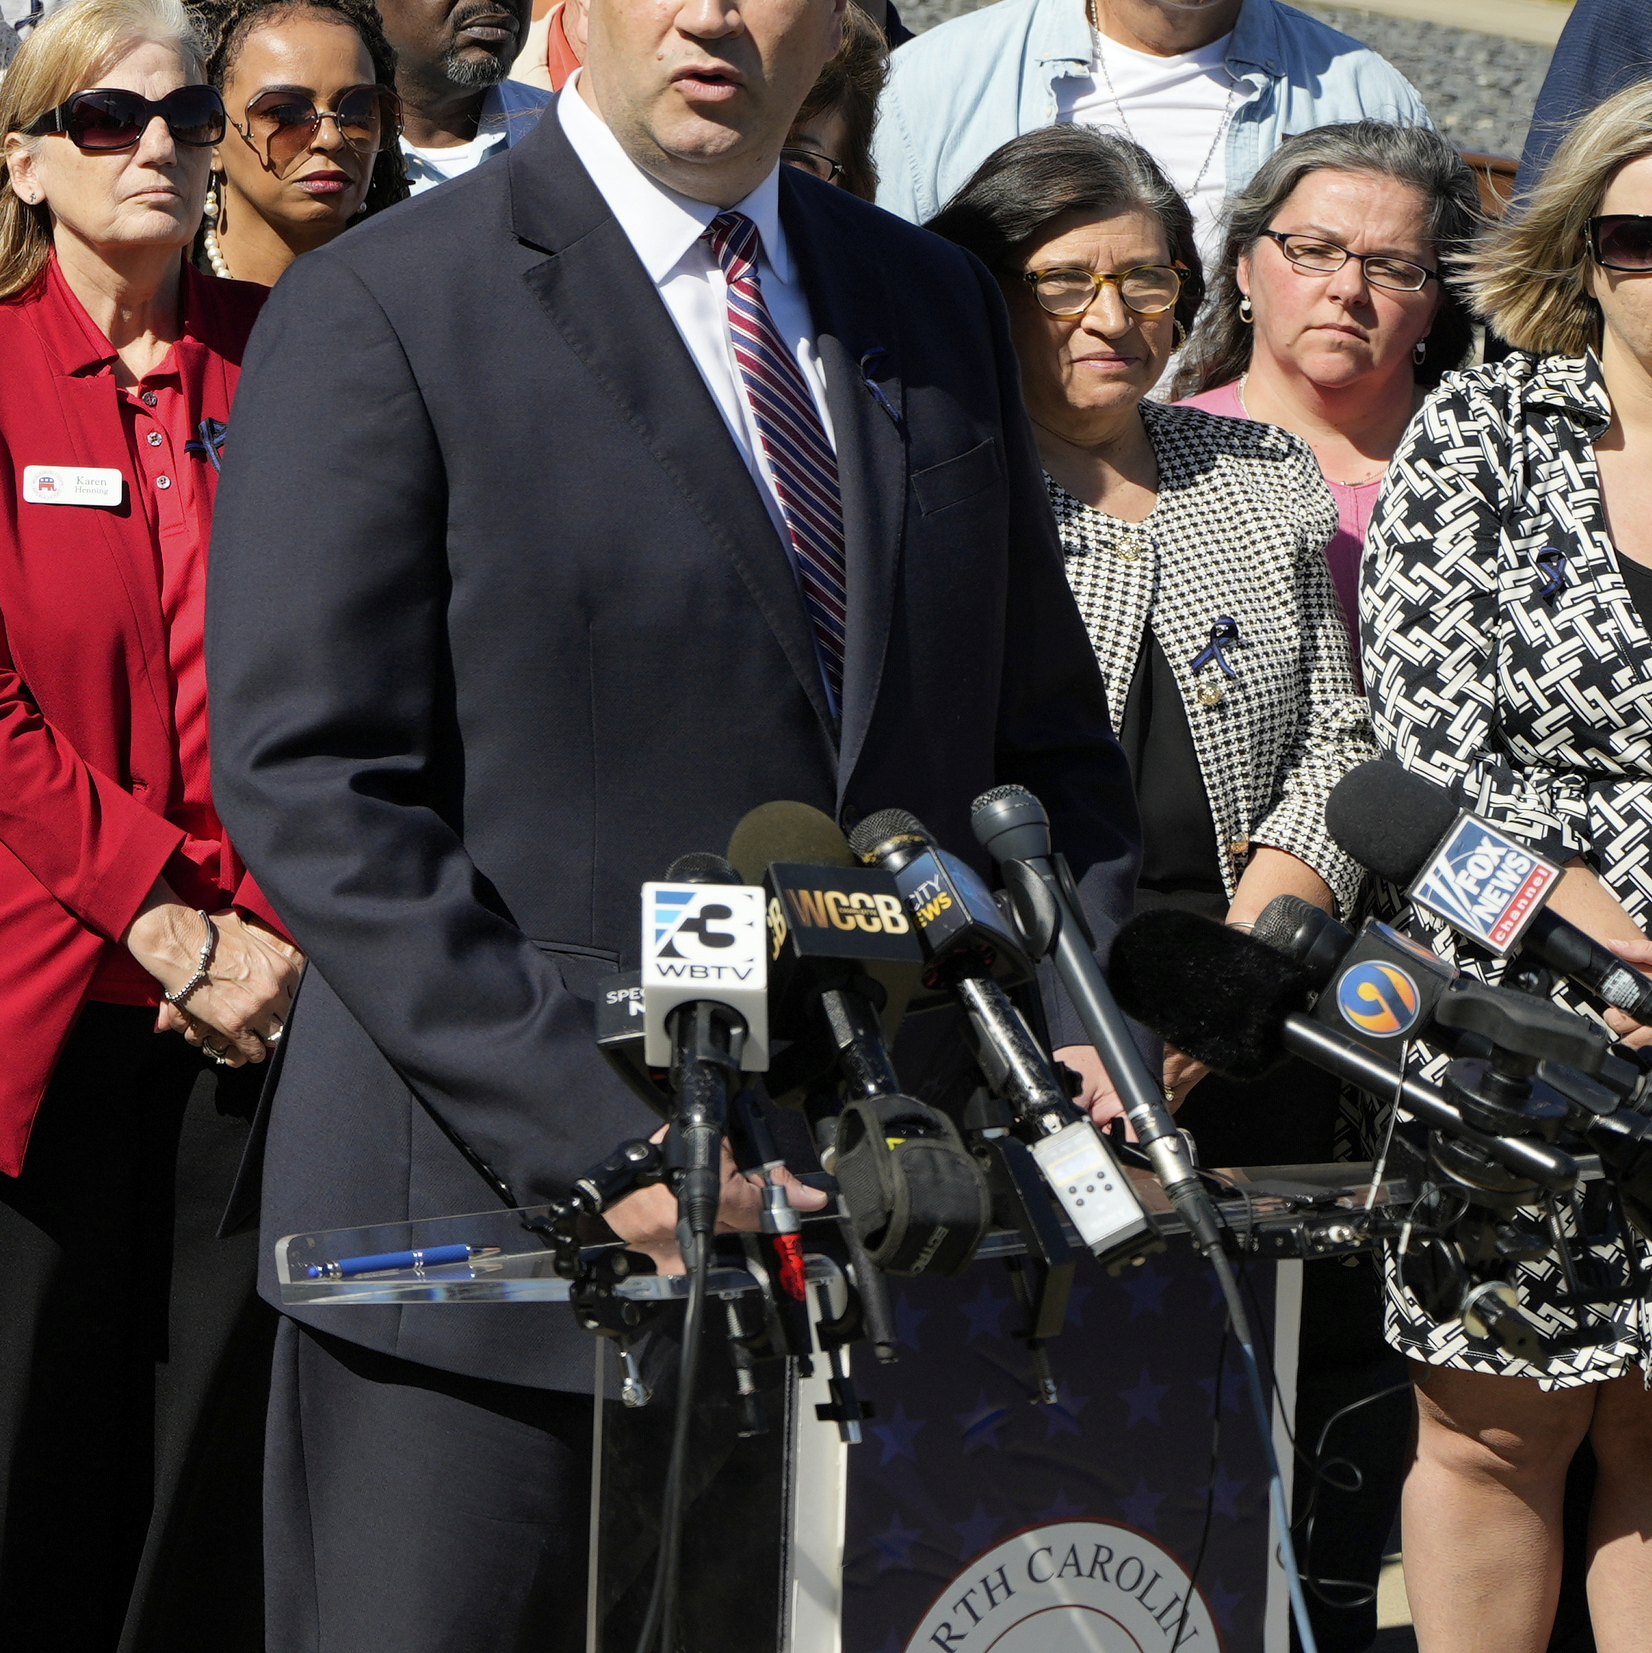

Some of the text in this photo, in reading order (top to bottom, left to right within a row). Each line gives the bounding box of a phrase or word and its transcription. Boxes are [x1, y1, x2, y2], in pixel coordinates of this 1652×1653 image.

[74, 486, 109, 495] Henning
[76, 476, 107, 486] Karen
[1454, 835, 1509, 896] FOX
[1470, 851, 1532, 925] NEWS
[786, 888, 910, 934] WCCB
[1495, 868, 1550, 943] channel
[656, 963, 753, 980] WBTV
[929, 1542, 1199, 1653] RTH CAROLIN
